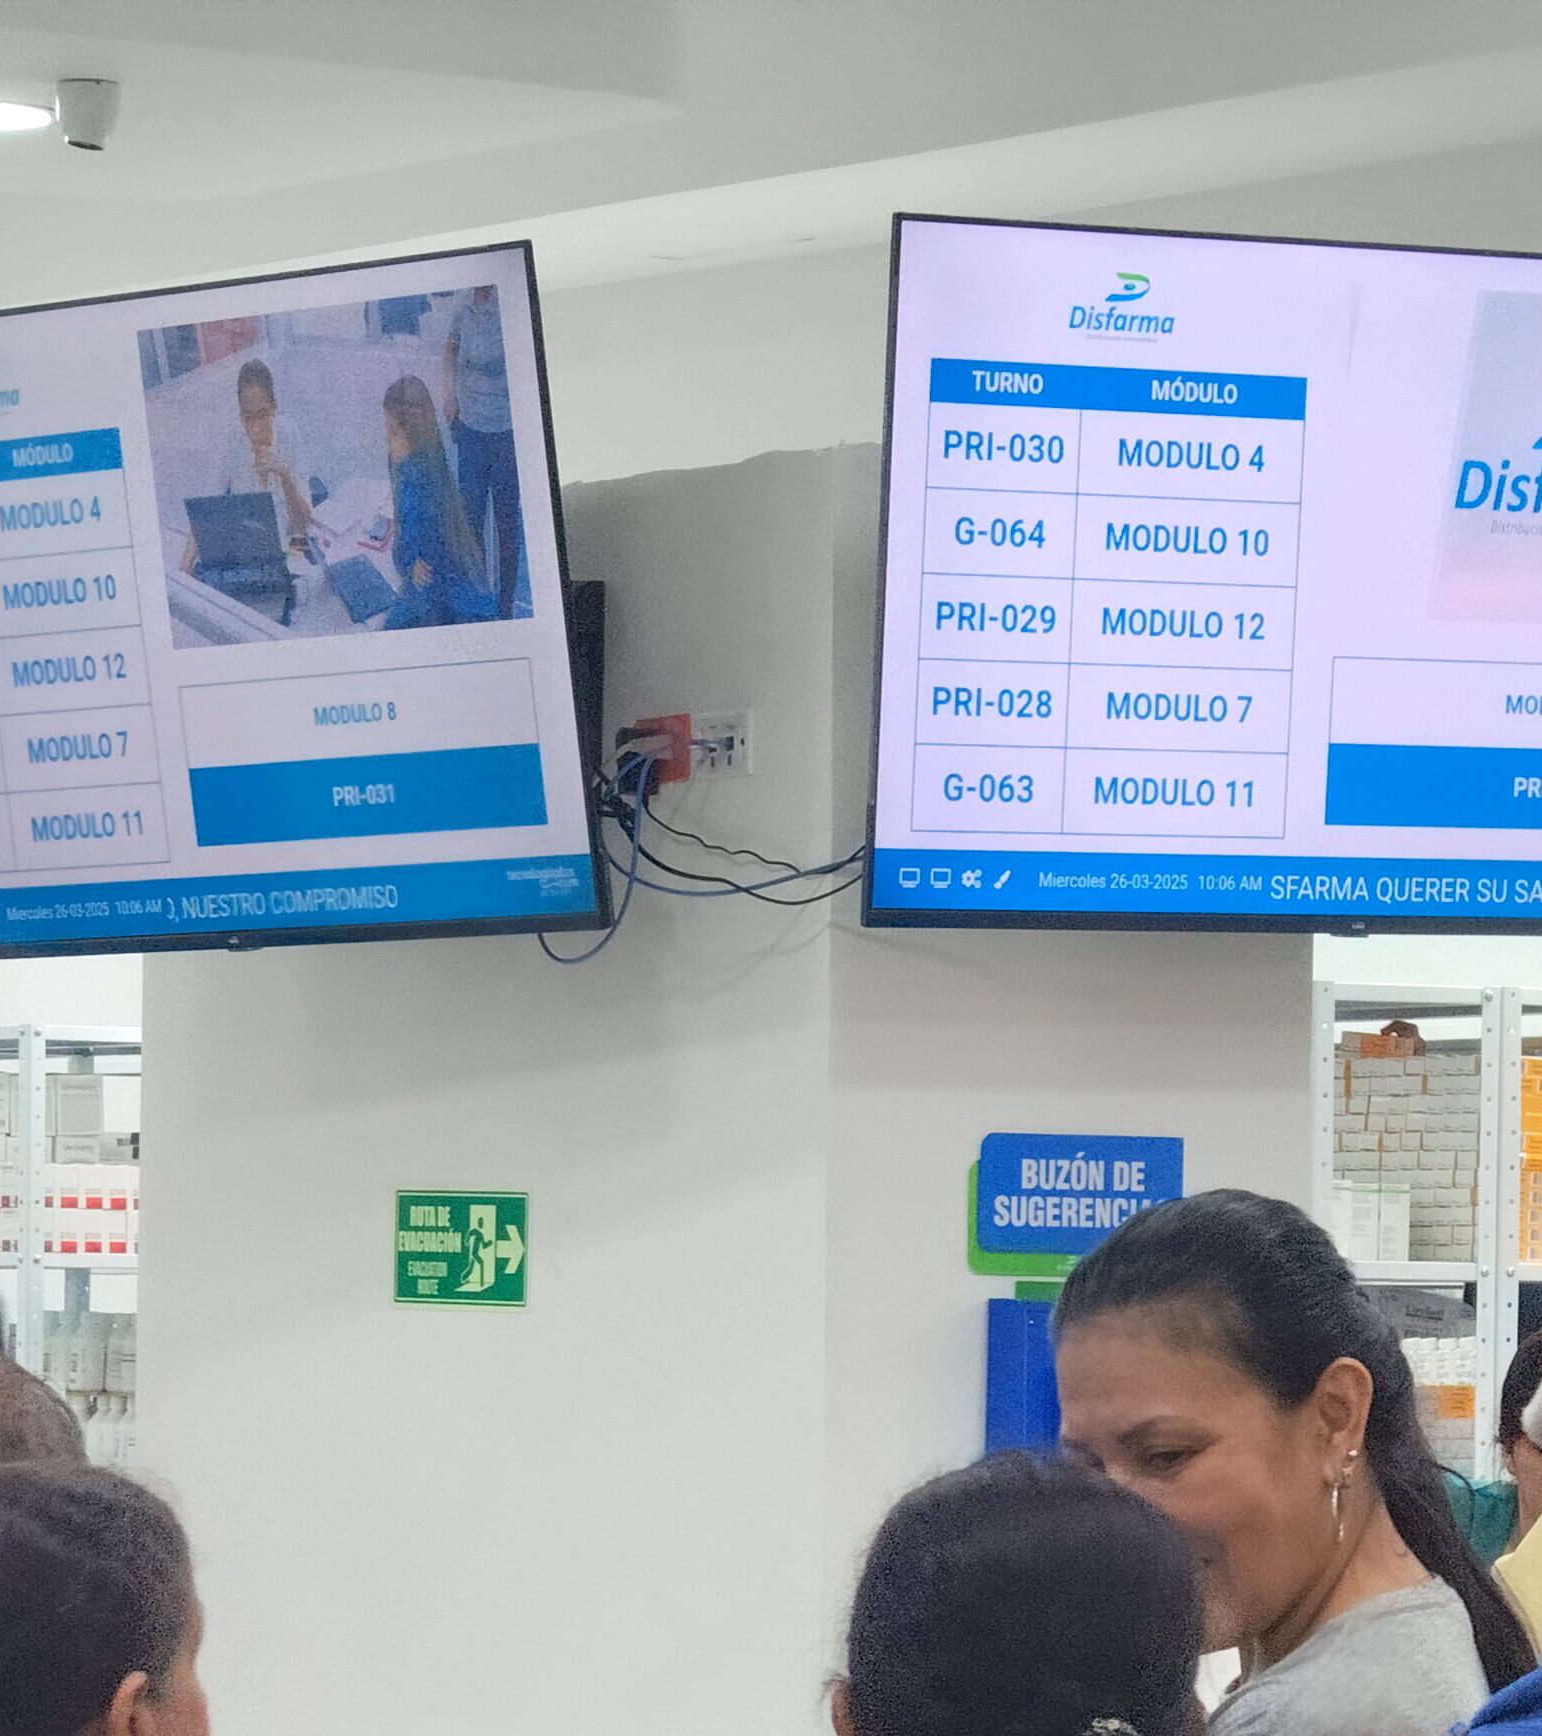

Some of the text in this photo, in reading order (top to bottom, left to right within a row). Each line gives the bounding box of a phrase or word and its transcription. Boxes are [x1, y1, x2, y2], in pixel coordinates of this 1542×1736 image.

[1069, 305, 1175, 334] Disfarma
[972, 370, 1238, 404] TURNO MÓDULO
[12, 442, 73, 467] MÓDULO
[943, 430, 1265, 473] PRI-030 MODULO 4
[0, 498, 84, 532] MODULO
[90, 496, 102, 522] 4
[954, 516, 1270, 557] G-064 MODULO 10
[2, 577, 87, 610] MODULO
[93, 574, 117, 602] 10
[936, 601, 1265, 640] PRI-029 MODULO 12
[12, 656, 96, 687] MODULO
[102, 653, 127, 680] 12
[313, 701, 397, 727] MODULO 8
[932, 686, 1253, 723] PRI-028 MODULO 7
[27, 733, 112, 764] MODULO
[116, 731, 128, 757] 7
[332, 784, 395, 807] PRI-031
[944, 773, 1254, 808] G-063 MODULO 11
[31, 811, 115, 842] MODULO
[121, 810, 144, 837] 11
[1039, 871, 1262, 891] Miercoles 26-03-2025 10:06 AM
[1270, 875, 1369, 902] SFARMA
[1376, 877, 1470, 904] QUERER
[1477, 878, 1508, 904] SU
[182, 890, 266, 920] NUESTRO
[270, 885, 398, 913] COMPROMISO
[1021, 1152, 1145, 1192] BUZÓN DE
[993, 1195, 1162, 1229] SUGERENCI
